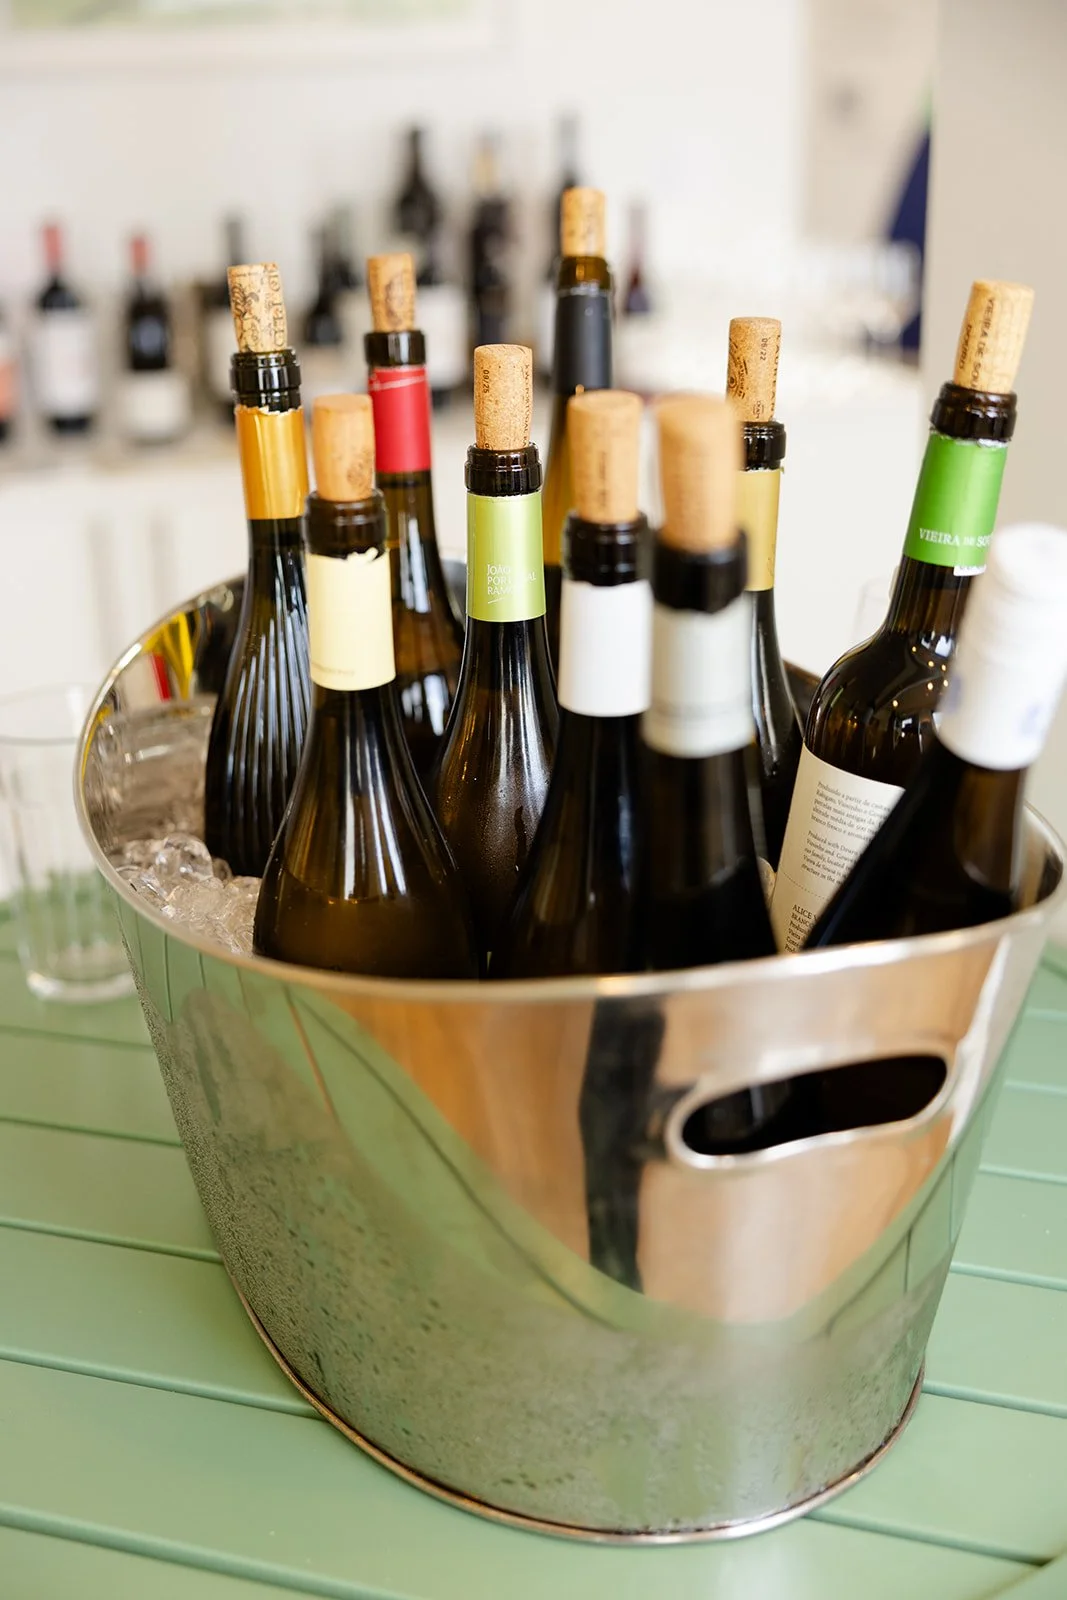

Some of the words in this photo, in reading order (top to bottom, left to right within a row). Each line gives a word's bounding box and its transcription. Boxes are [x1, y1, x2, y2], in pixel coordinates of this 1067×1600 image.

[482, 369, 490, 394] 09/25
[919, 527, 960, 547] VIEIRA
[487, 572, 537, 586] PORTAL
[792, 904, 812, 919] ALICE
